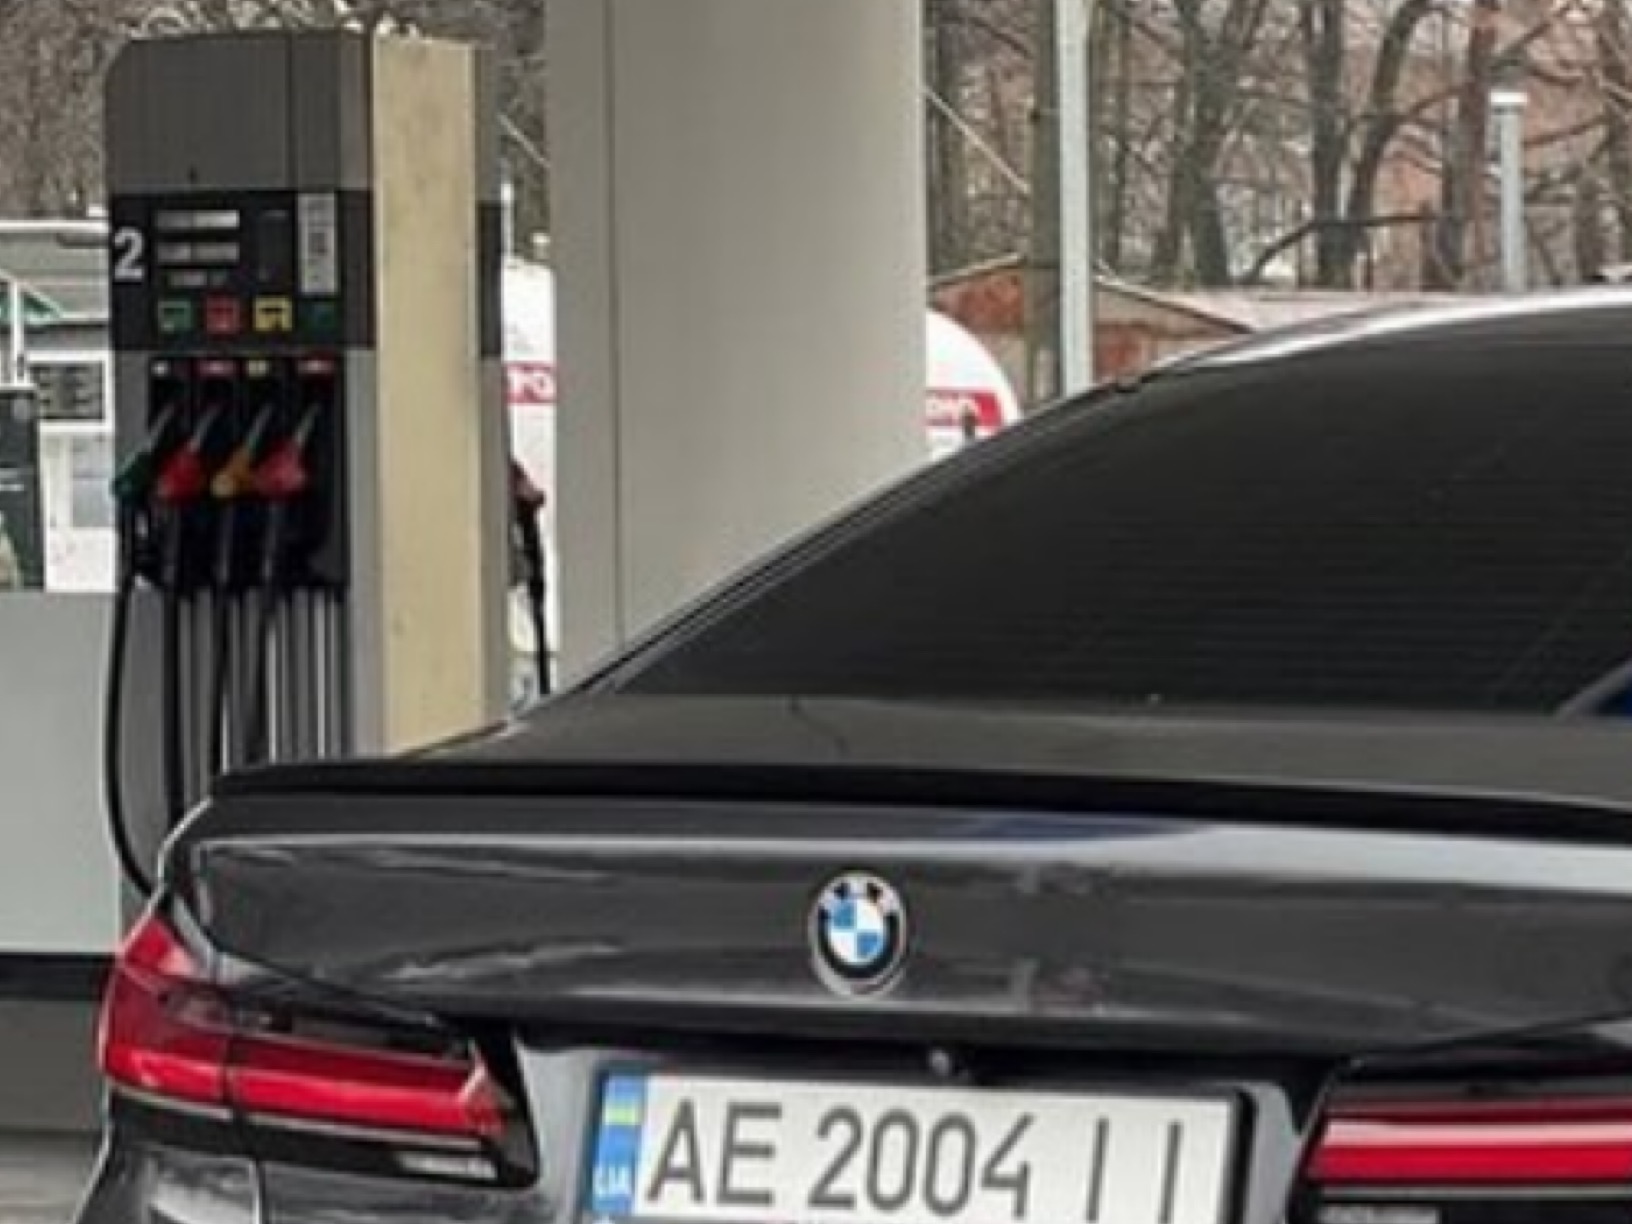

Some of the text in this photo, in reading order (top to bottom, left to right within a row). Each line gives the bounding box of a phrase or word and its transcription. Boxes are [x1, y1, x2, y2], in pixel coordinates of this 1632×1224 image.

[114, 228, 144, 279] 2
[646, 1100, 782, 1206] AE
[808, 1107, 1034, 1221] 2004
